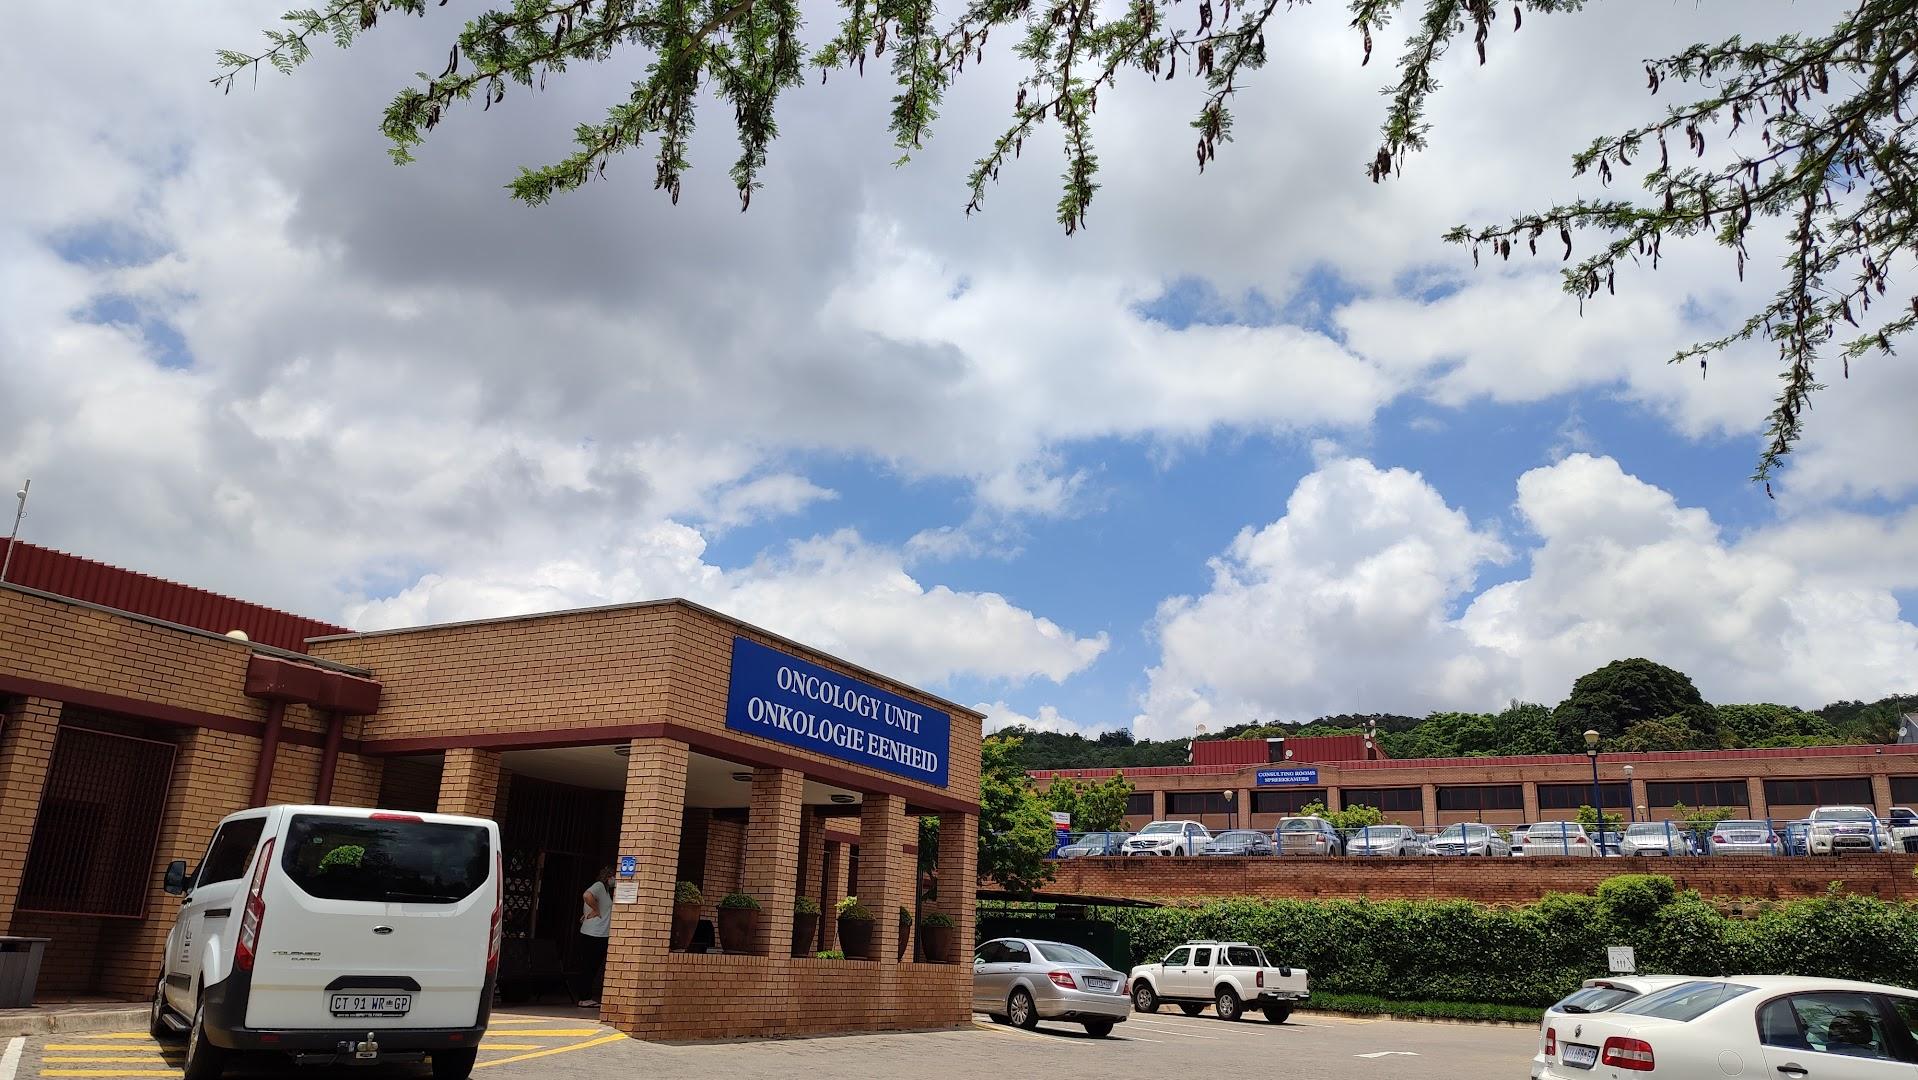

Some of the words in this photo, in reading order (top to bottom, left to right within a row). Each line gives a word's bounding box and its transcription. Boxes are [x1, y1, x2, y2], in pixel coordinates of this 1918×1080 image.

[777, 667, 881, 720] ONCOLOGY
[884, 705, 922, 734] UNIT
[748, 697, 864, 752] ONKOLOGIE
[867, 733, 937, 773] EENHEID
[335, 998, 349, 1009] CT
[354, 998, 366, 1009] 91
[371, 998, 385, 1009] WR
[394, 998, 407, 1009] GP
